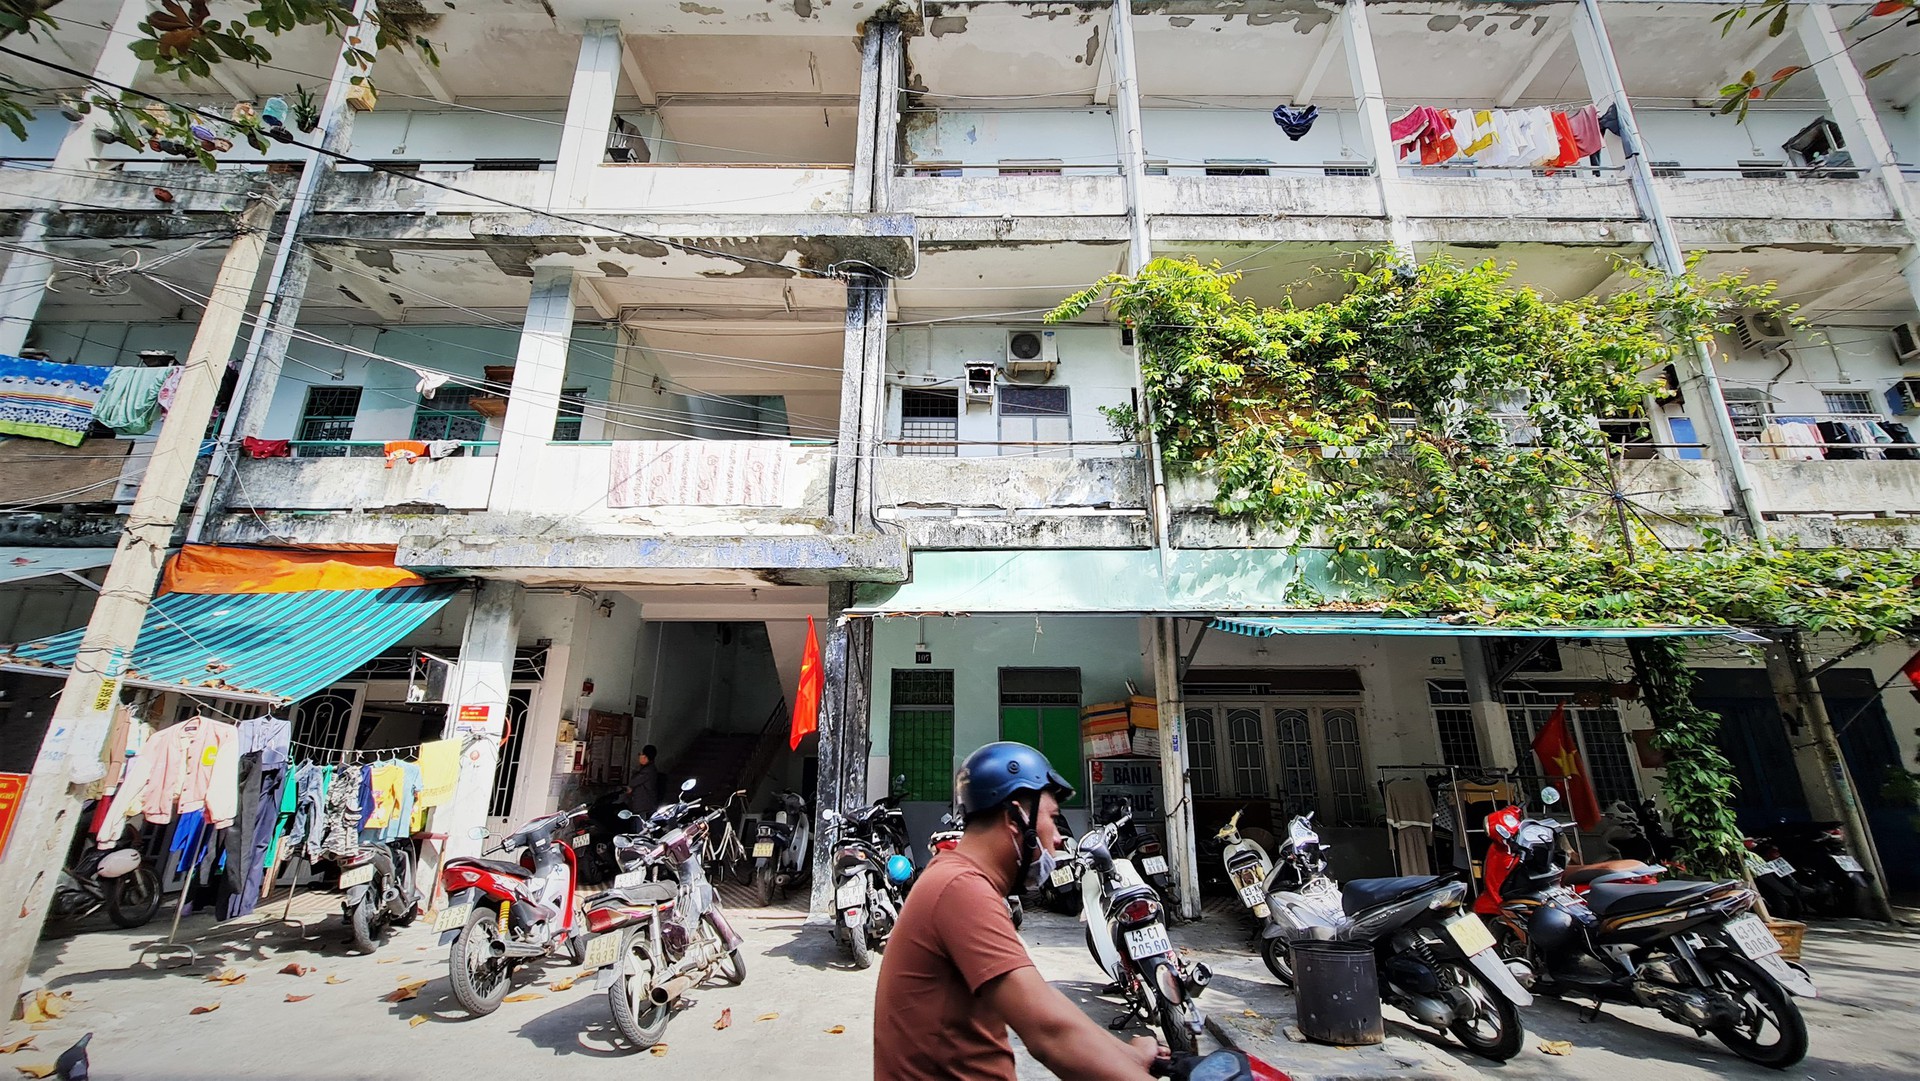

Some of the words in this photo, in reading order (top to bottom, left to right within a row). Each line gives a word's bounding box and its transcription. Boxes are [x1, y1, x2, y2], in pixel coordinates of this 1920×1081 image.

[202, 746, 217, 766] C
[1113, 763, 1152, 784] BÁNH
[1131, 926, 1160, 943] 43-C1
[1733, 921, 1762, 940] 43-P1
[1131, 938, 1169, 958] 205.60
[1744, 935, 1774, 955] 9068
[589, 948, 615, 966] 5933
